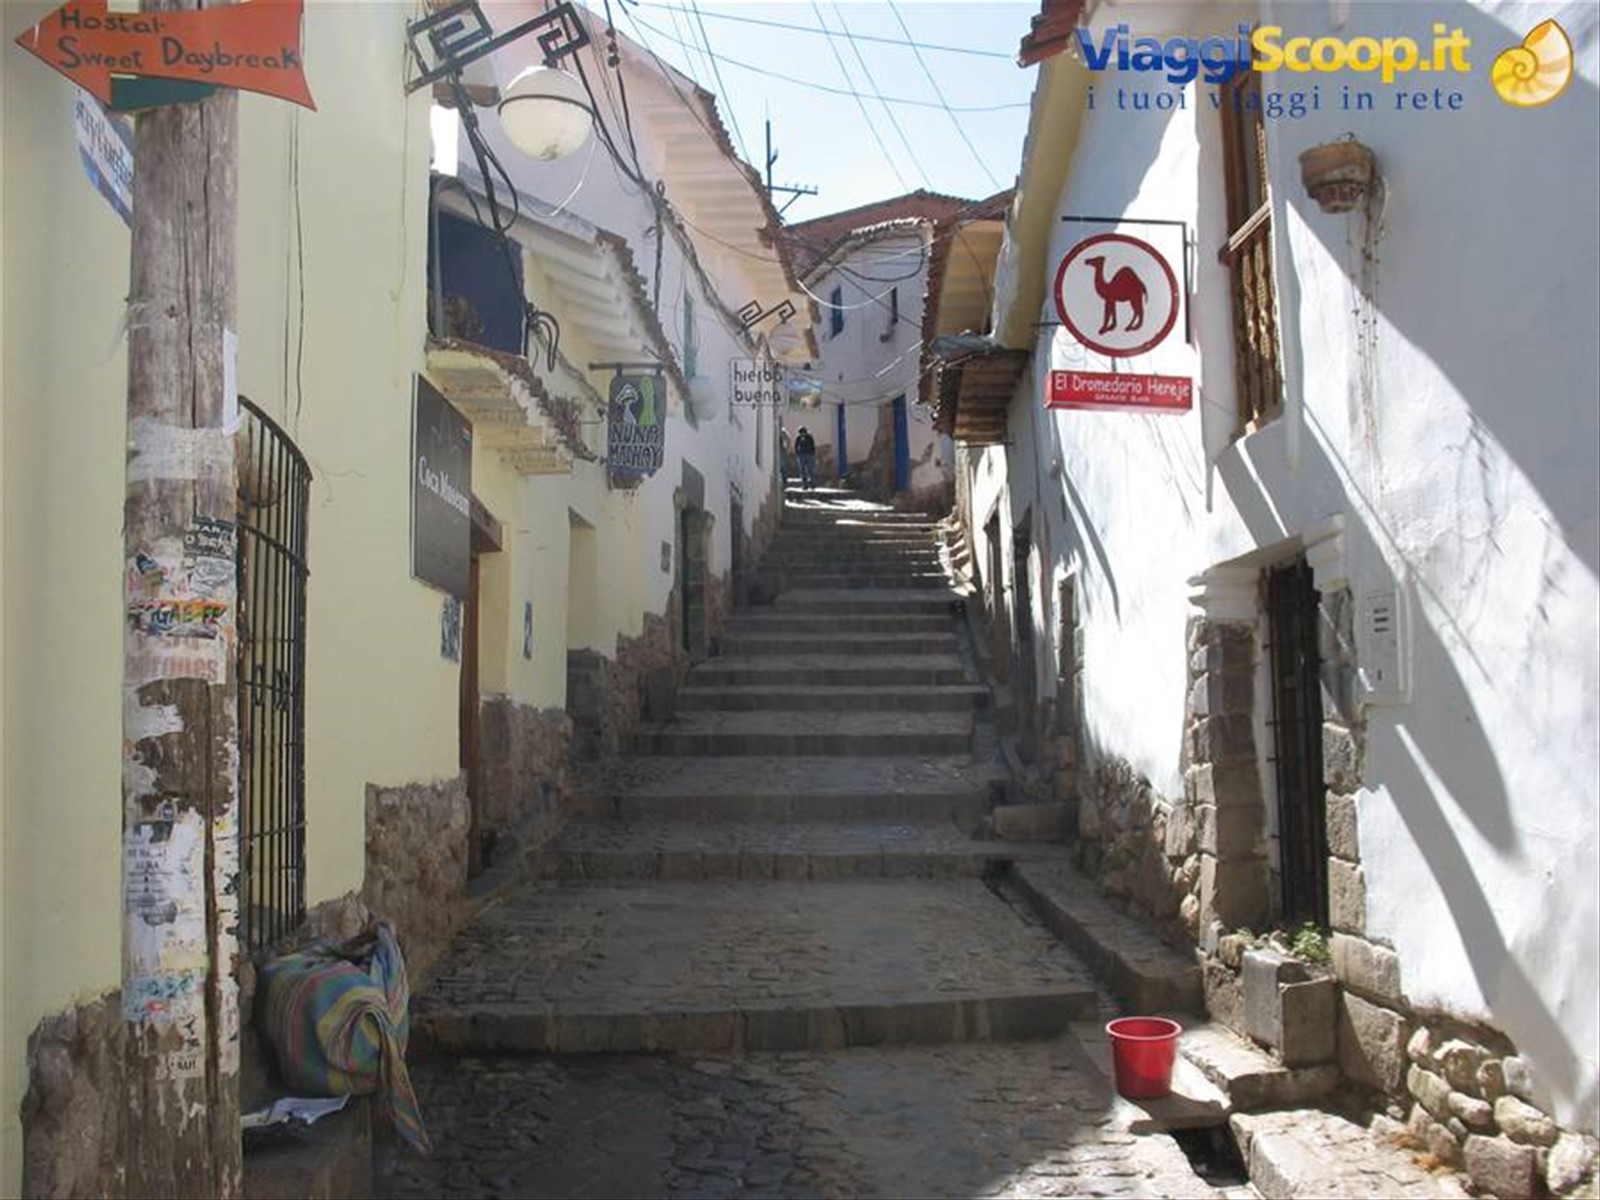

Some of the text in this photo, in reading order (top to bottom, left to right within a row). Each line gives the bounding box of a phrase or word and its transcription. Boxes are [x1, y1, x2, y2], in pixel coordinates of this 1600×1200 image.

[57, 36, 300, 73] Sweet Daybreak
[734, 362, 782, 382] hierba
[734, 385, 781, 402] buena
[1055, 373, 1067, 390] El
[1073, 375, 1141, 394] Dromedario
[1147, 379, 1190, 401] Hereje
